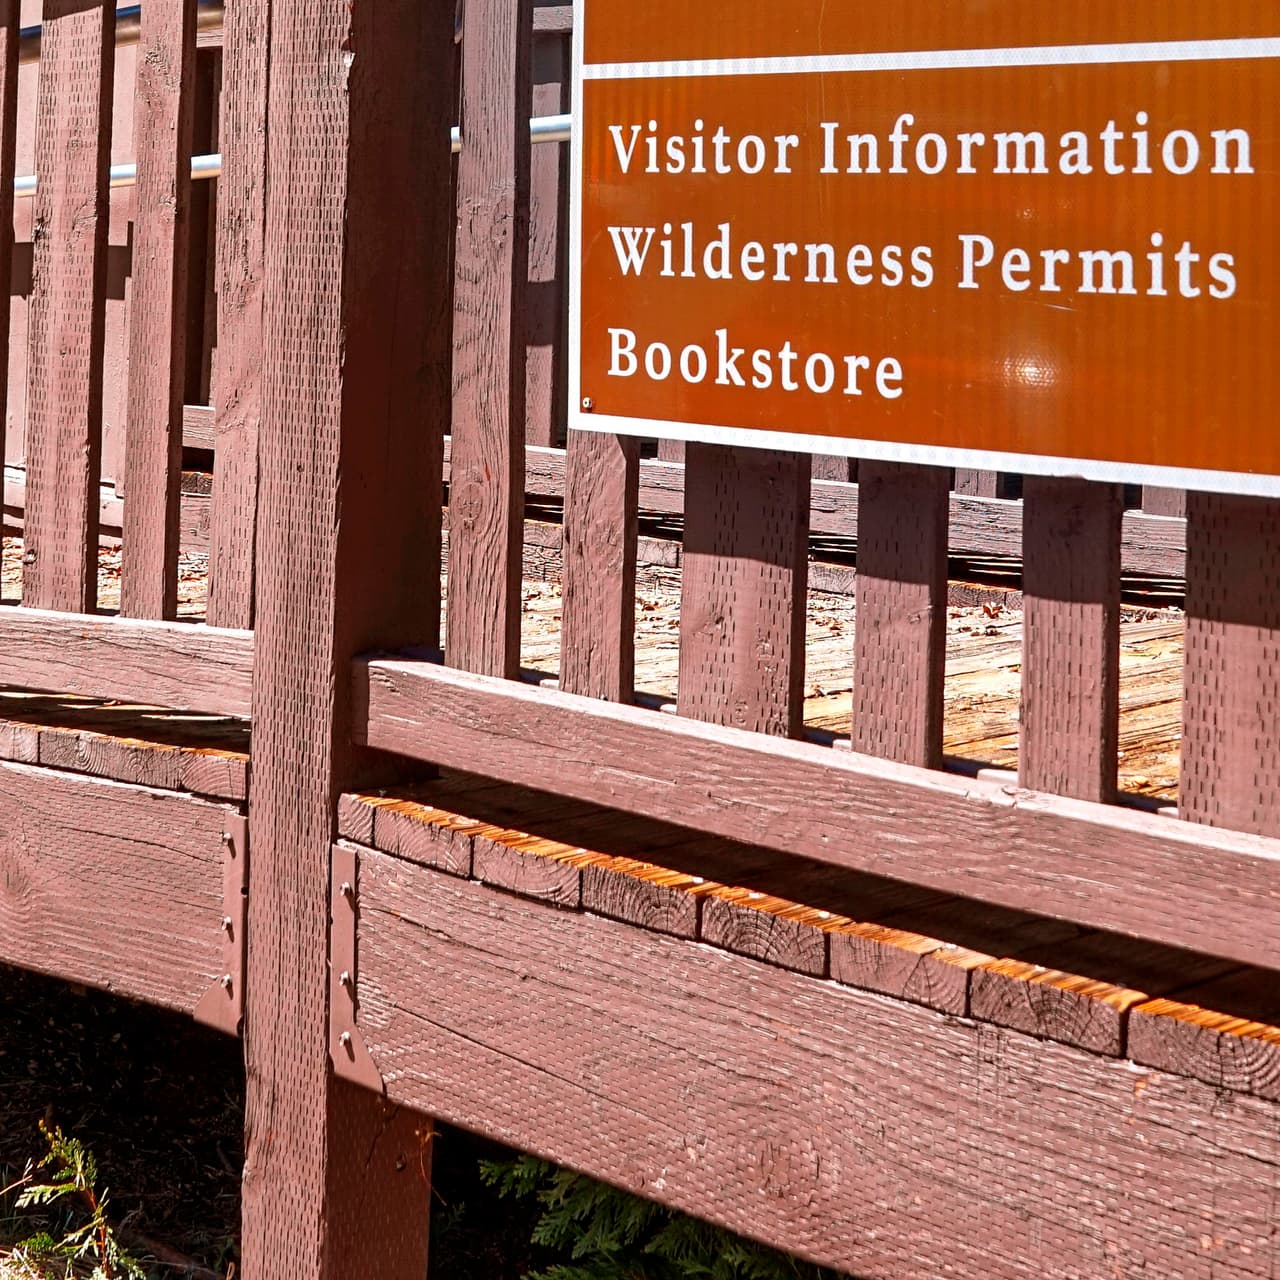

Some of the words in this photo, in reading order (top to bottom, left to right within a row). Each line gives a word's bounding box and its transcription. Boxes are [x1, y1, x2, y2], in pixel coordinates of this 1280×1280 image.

[607, 118, 800, 175] Visitor
[819, 111, 1256, 175] Information
[606, 221, 934, 288] Wilderness
[957, 232, 1238, 300] Permits
[607, 327, 904, 400] Bookstore
